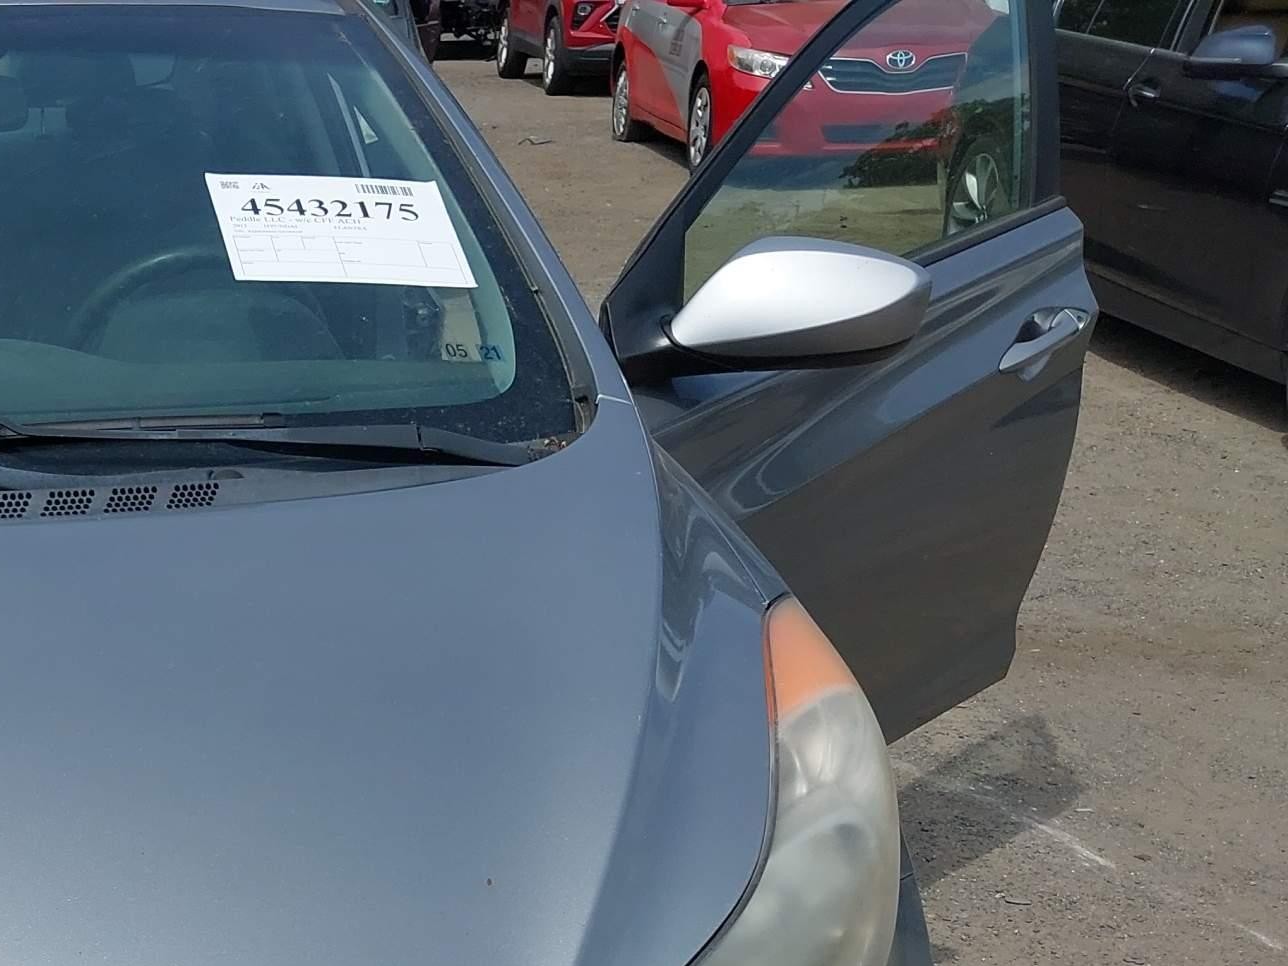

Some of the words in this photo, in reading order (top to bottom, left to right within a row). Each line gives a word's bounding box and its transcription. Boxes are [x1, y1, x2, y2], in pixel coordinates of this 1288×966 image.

[241, 197, 420, 222] 45432175
[445, 343, 468, 358] 05
[479, 345, 501, 360] 21
